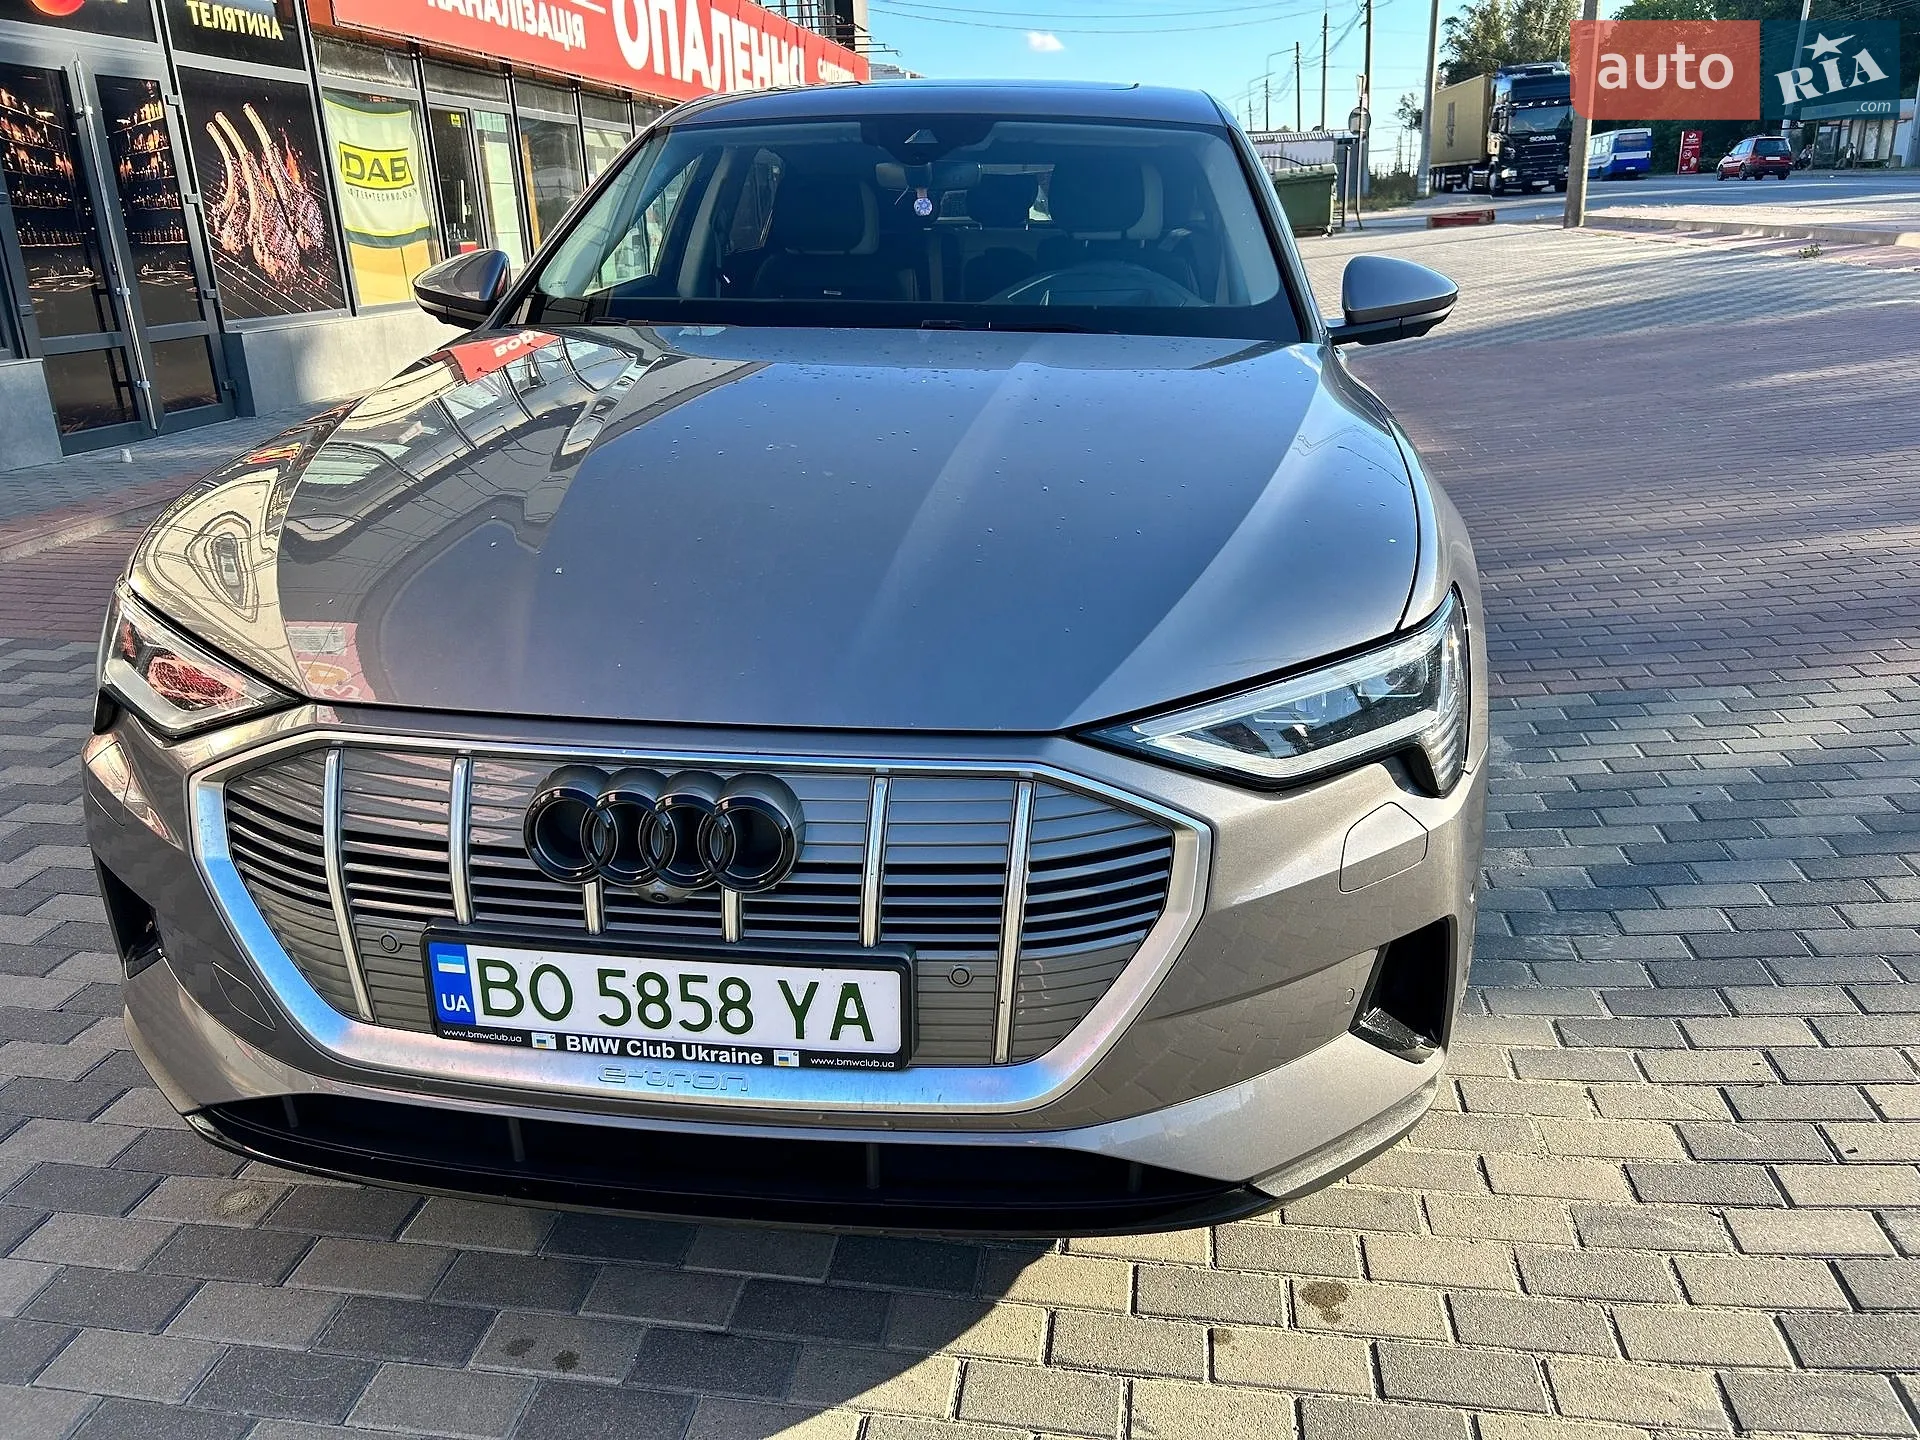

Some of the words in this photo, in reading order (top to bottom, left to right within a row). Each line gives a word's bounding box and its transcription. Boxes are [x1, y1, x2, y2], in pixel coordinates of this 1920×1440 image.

[185, 0, 284, 41] ТЕЛЯТИНА
[427, 0, 586, 51] НАЛІЗАЦІЯ
[1529, 134, 1557, 143] SCANIA
[343, 151, 408, 183] DAB
[442, 993, 471, 1013] UA
[476, 957, 574, 1022] BO
[597, 968, 754, 1035] 5858
[777, 978, 876, 1042] YA
[443, 1027, 522, 1043] www.bmwclub.ua
[566, 1035, 620, 1055] BMW
[626, 1041, 675, 1059] Club
[682, 1043, 763, 1065] Ukraine
[810, 1056, 895, 1069] www.bmwclub.ua
[598, 1063, 749, 1092] e-tron
